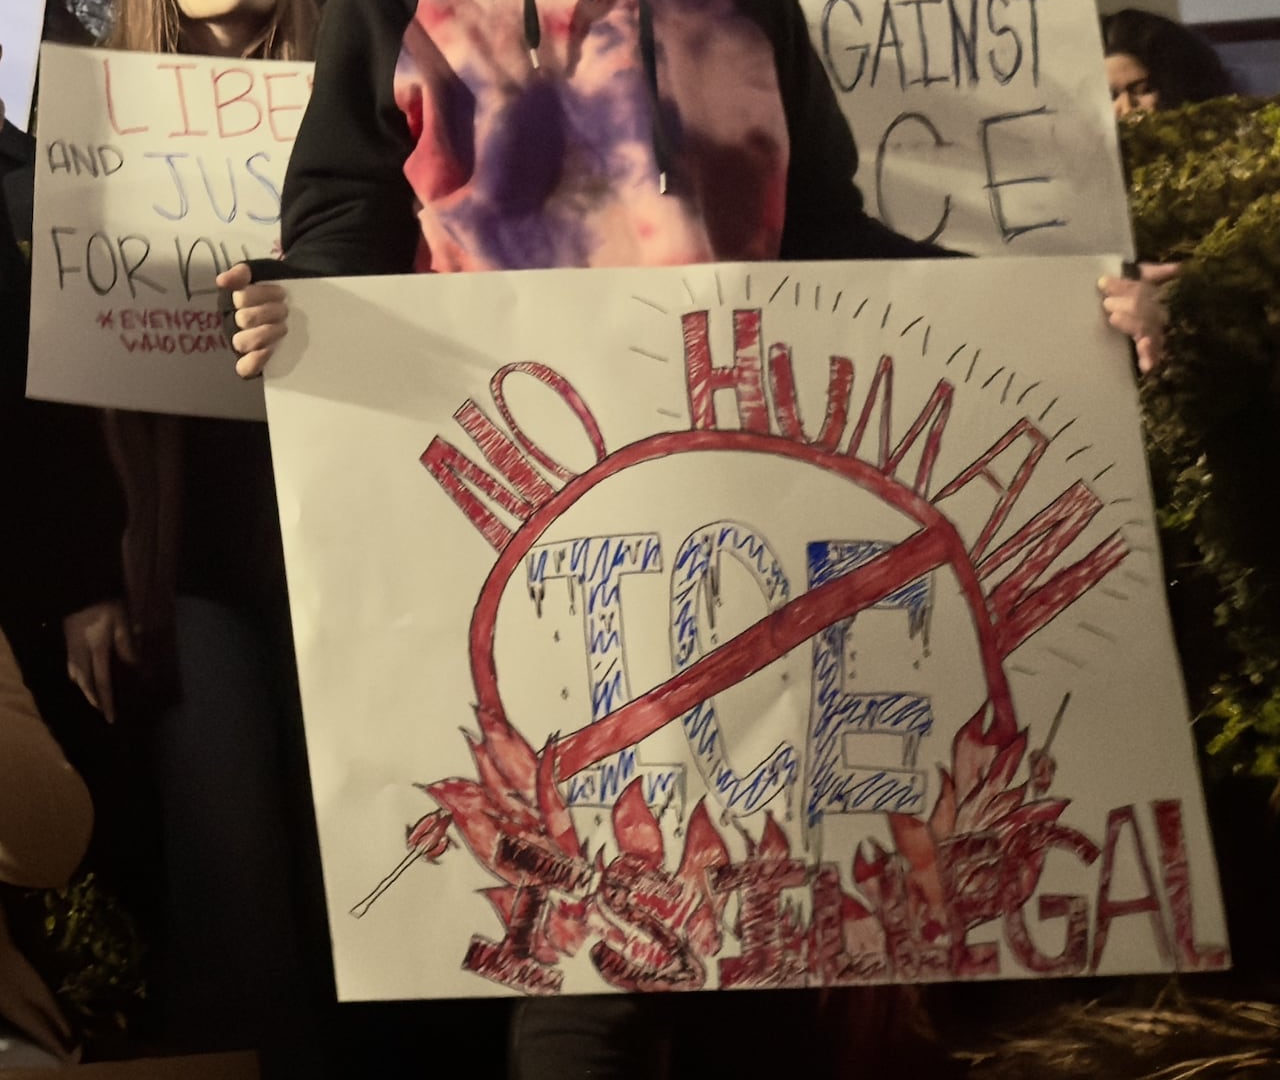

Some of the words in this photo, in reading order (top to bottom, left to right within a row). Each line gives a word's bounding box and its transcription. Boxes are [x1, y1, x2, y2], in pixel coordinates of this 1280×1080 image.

[103, 58, 313, 142] LIBE
[47, 138, 124, 178] AND
[51, 225, 167, 299] FOR
[419, 362, 606, 554] NO
[682, 308, 1132, 658] HUMAN
[527, 519, 934, 820] ICE
